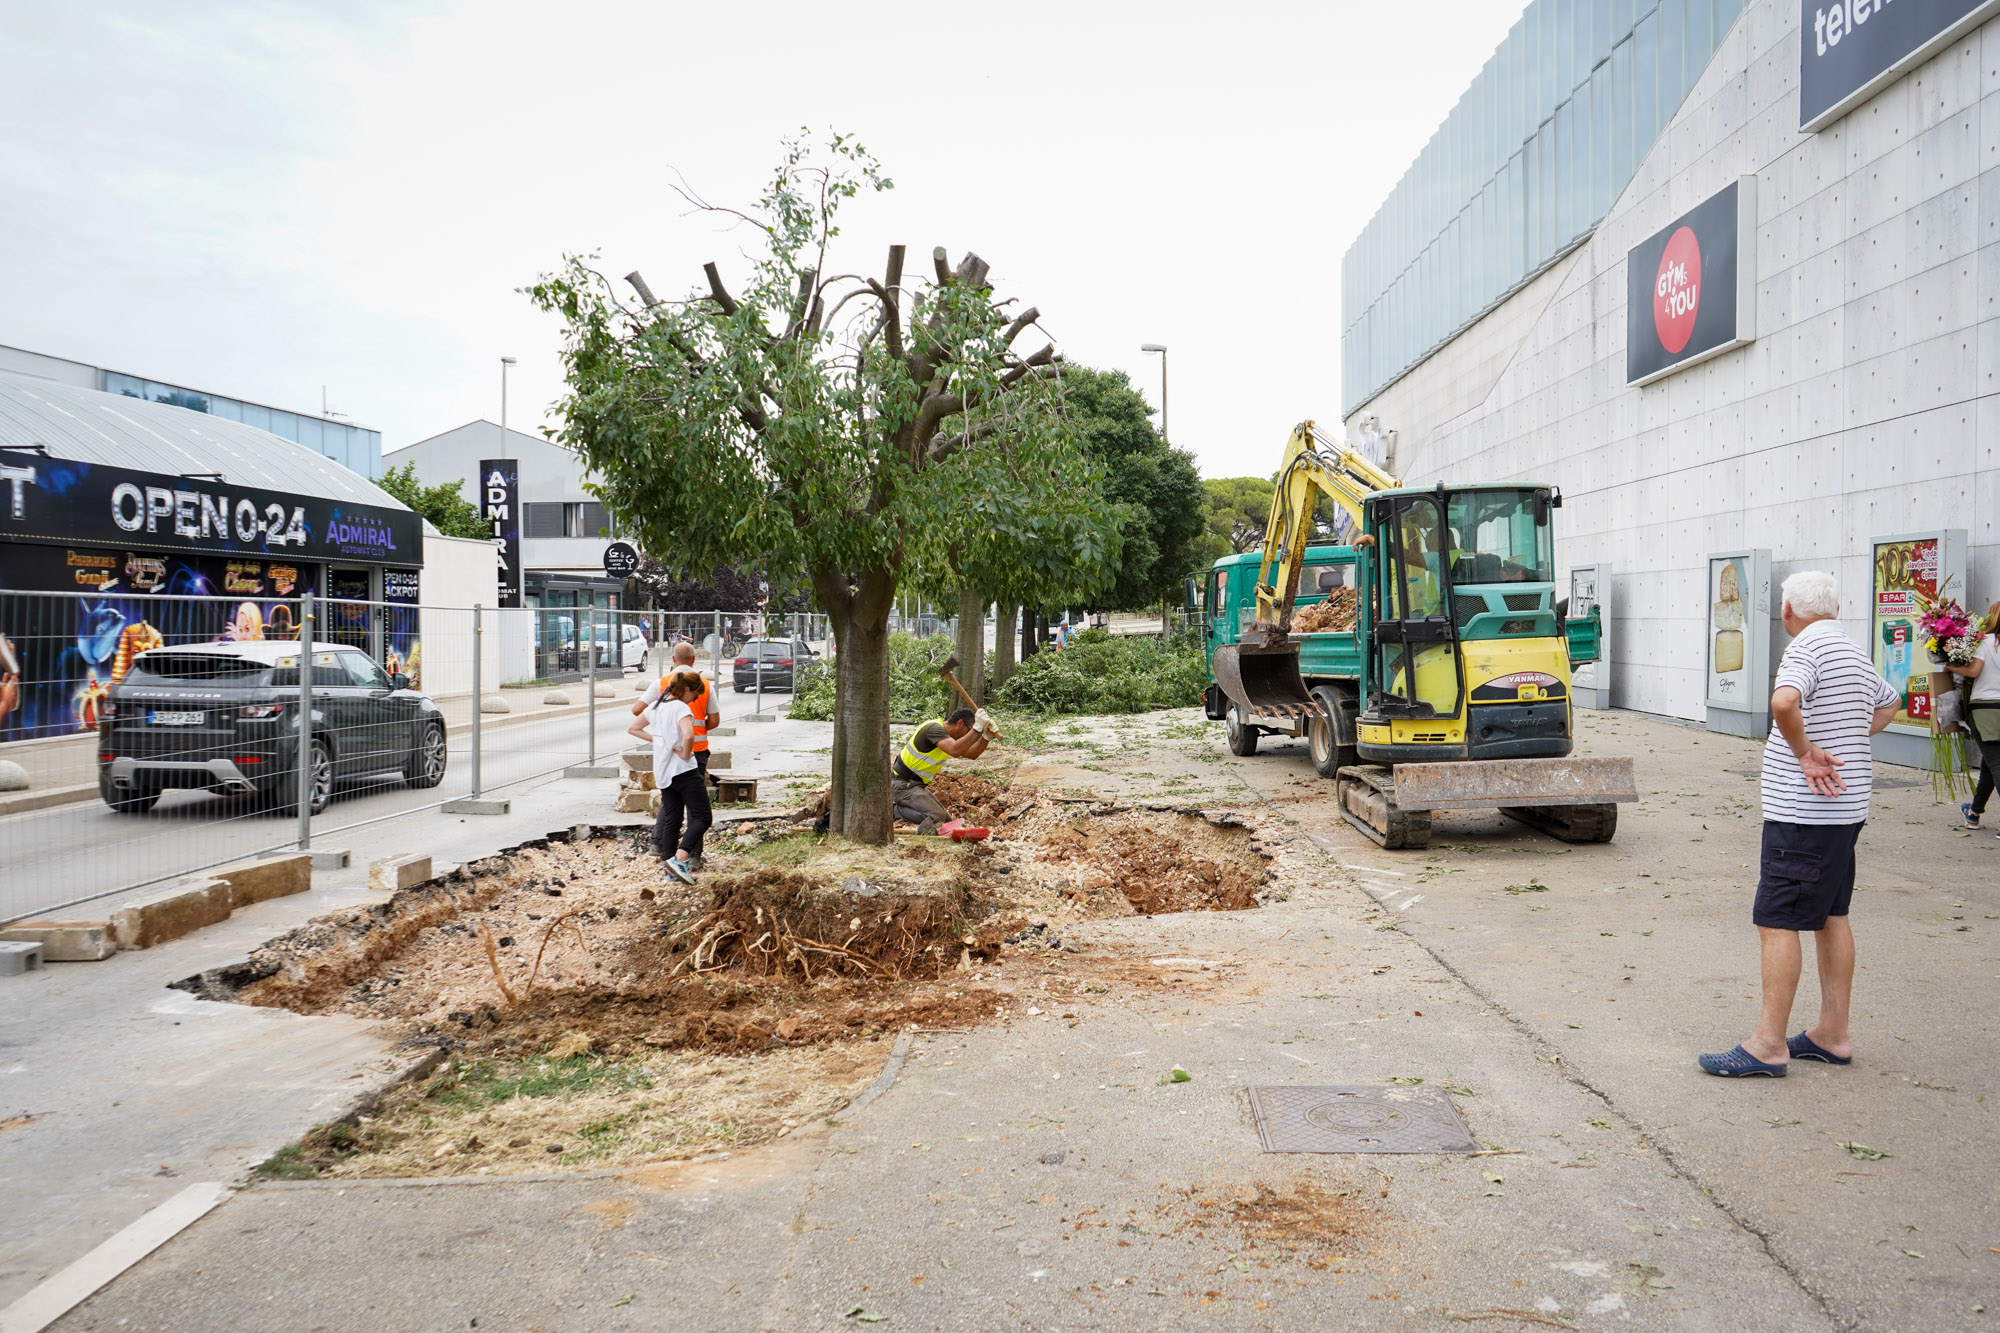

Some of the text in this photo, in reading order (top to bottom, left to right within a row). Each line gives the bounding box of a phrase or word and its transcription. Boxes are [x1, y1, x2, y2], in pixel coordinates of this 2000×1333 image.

[1814, 0, 1893, 56] tele
[1670, 286, 1696, 319] YOU
[111, 482, 307, 547] OPEN 0-24
[325, 520, 397, 550] ADMIRAL
[1882, 593, 1906, 602] SPAR
[1878, 606, 1914, 614] SUPERMARKET
[1508, 674, 1546, 684] YANMAR
[1914, 677, 1927, 685] SUPER
